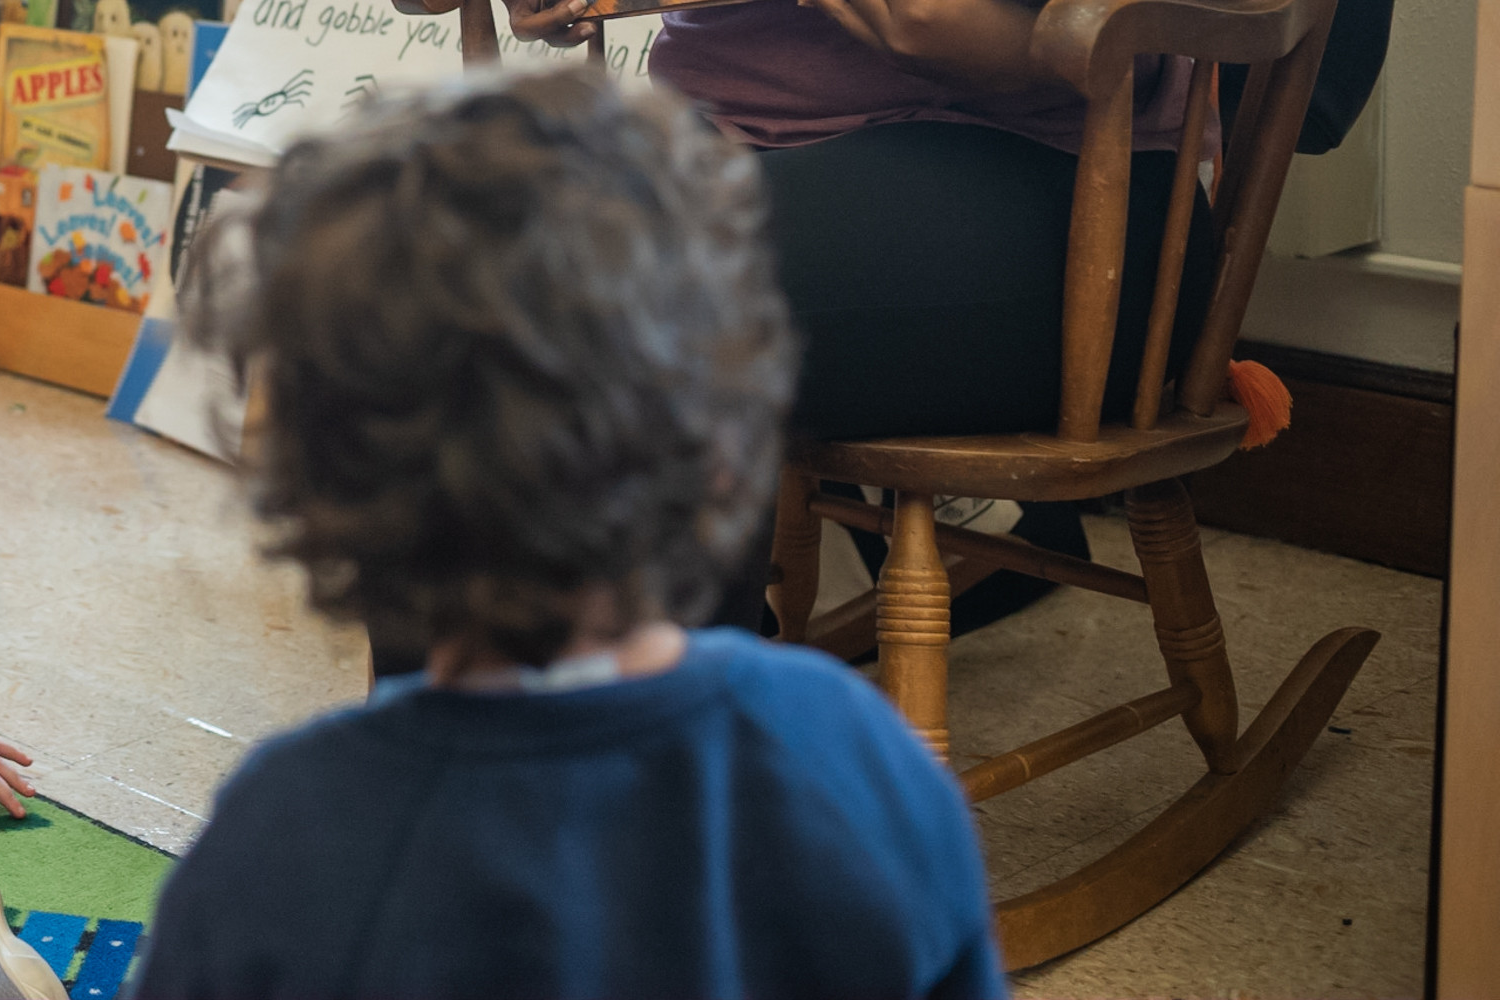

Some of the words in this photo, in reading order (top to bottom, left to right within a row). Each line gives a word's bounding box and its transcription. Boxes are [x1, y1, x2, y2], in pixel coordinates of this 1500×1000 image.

[305, 2, 394, 47] gobble
[398, 17, 449, 61] you
[12, 60, 104, 106] APPLES
